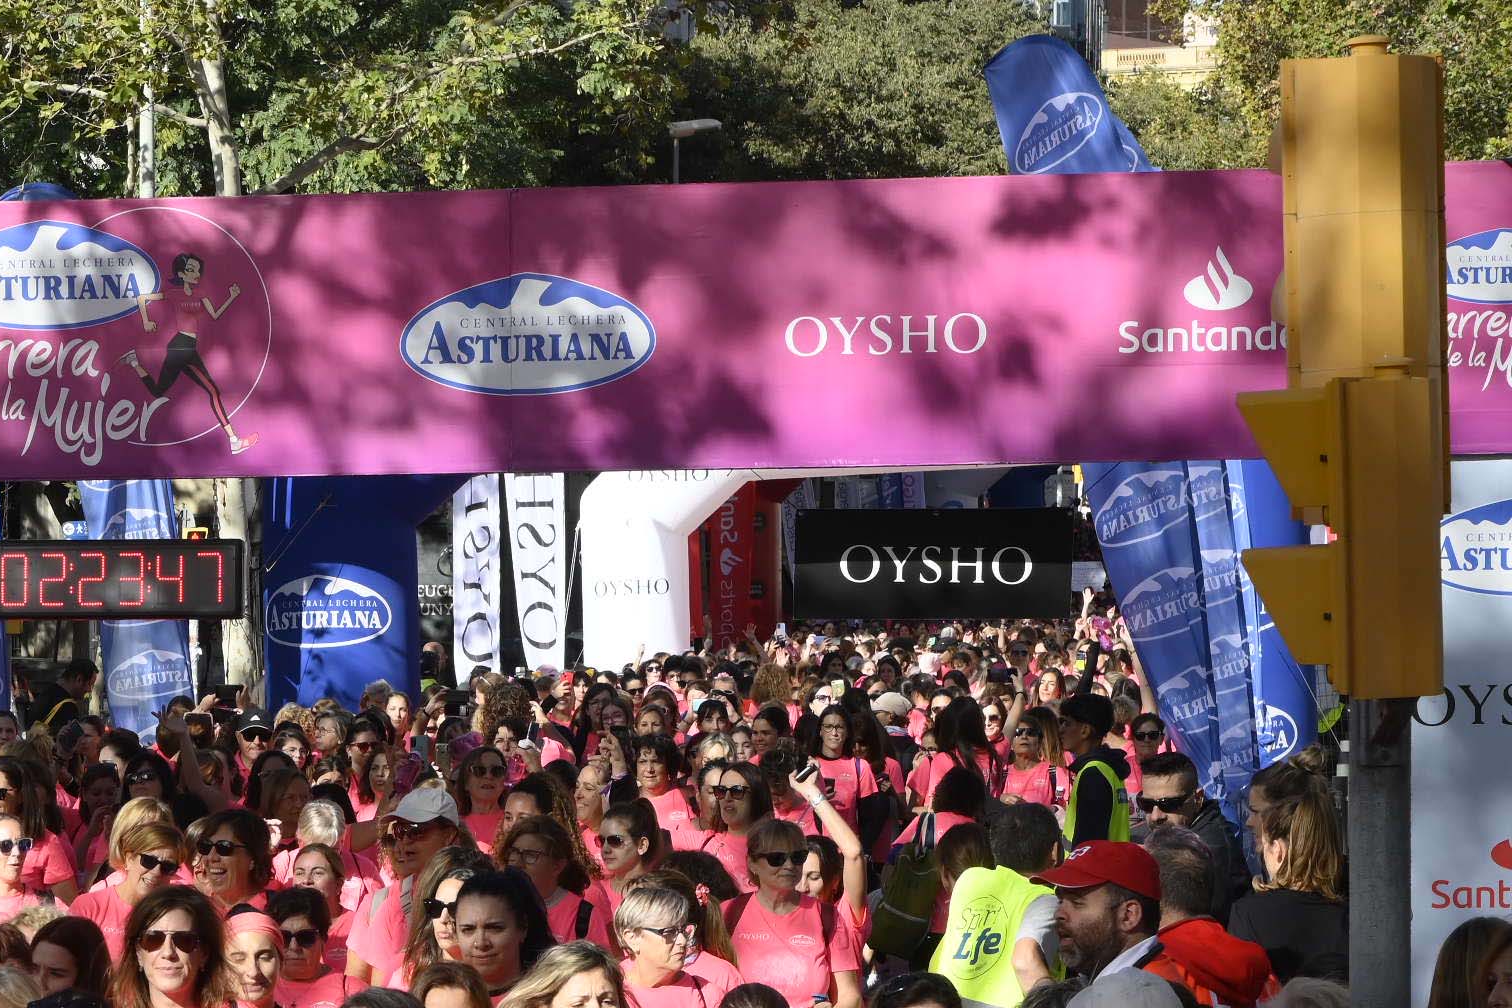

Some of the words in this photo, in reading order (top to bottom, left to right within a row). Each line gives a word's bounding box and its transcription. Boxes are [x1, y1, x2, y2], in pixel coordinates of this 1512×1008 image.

[63, 258, 135, 268] LECHERA
[460, 315, 533, 328] CENTRAL
[540, 314, 628, 327] LECHERA
[784, 312, 988, 358] OYSHO
[1118, 319, 1288, 354] Santand
[420, 320, 636, 366] ASTURIANA
[1, 381, 26, 421] la
[20, 372, 170, 466] Mujer
[0, 552, 223, 607] 02:23:47
[839, 544, 1033, 585] OYSHO
[328, 599, 378, 607] LECHERA
[594, 576, 670, 598] OYSHO
[269, 606, 383, 632] ASTURIANA
